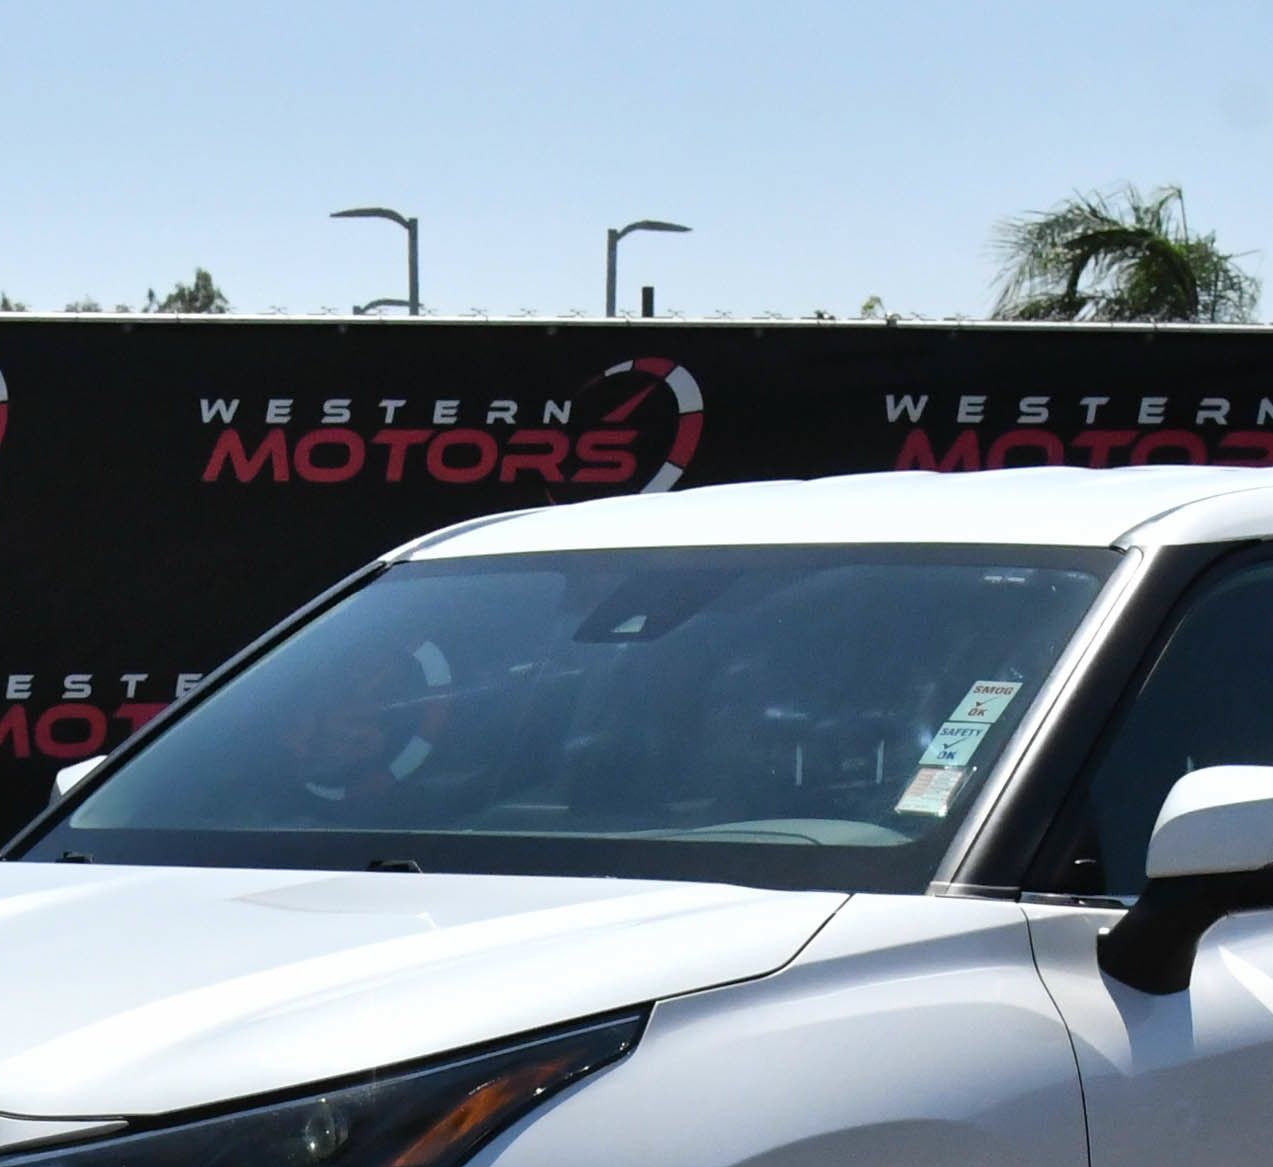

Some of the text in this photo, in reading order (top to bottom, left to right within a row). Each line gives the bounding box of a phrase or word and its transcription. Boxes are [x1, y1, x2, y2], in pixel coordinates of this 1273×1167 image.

[200, 398, 572, 425] WESTERN
[202, 427, 639, 484] MOTORS
[973, 685, 1014, 695] SMOG
[968, 708, 988, 717] OK
[939, 727, 984, 737] SAFETY
[937, 751, 956, 760] OK
